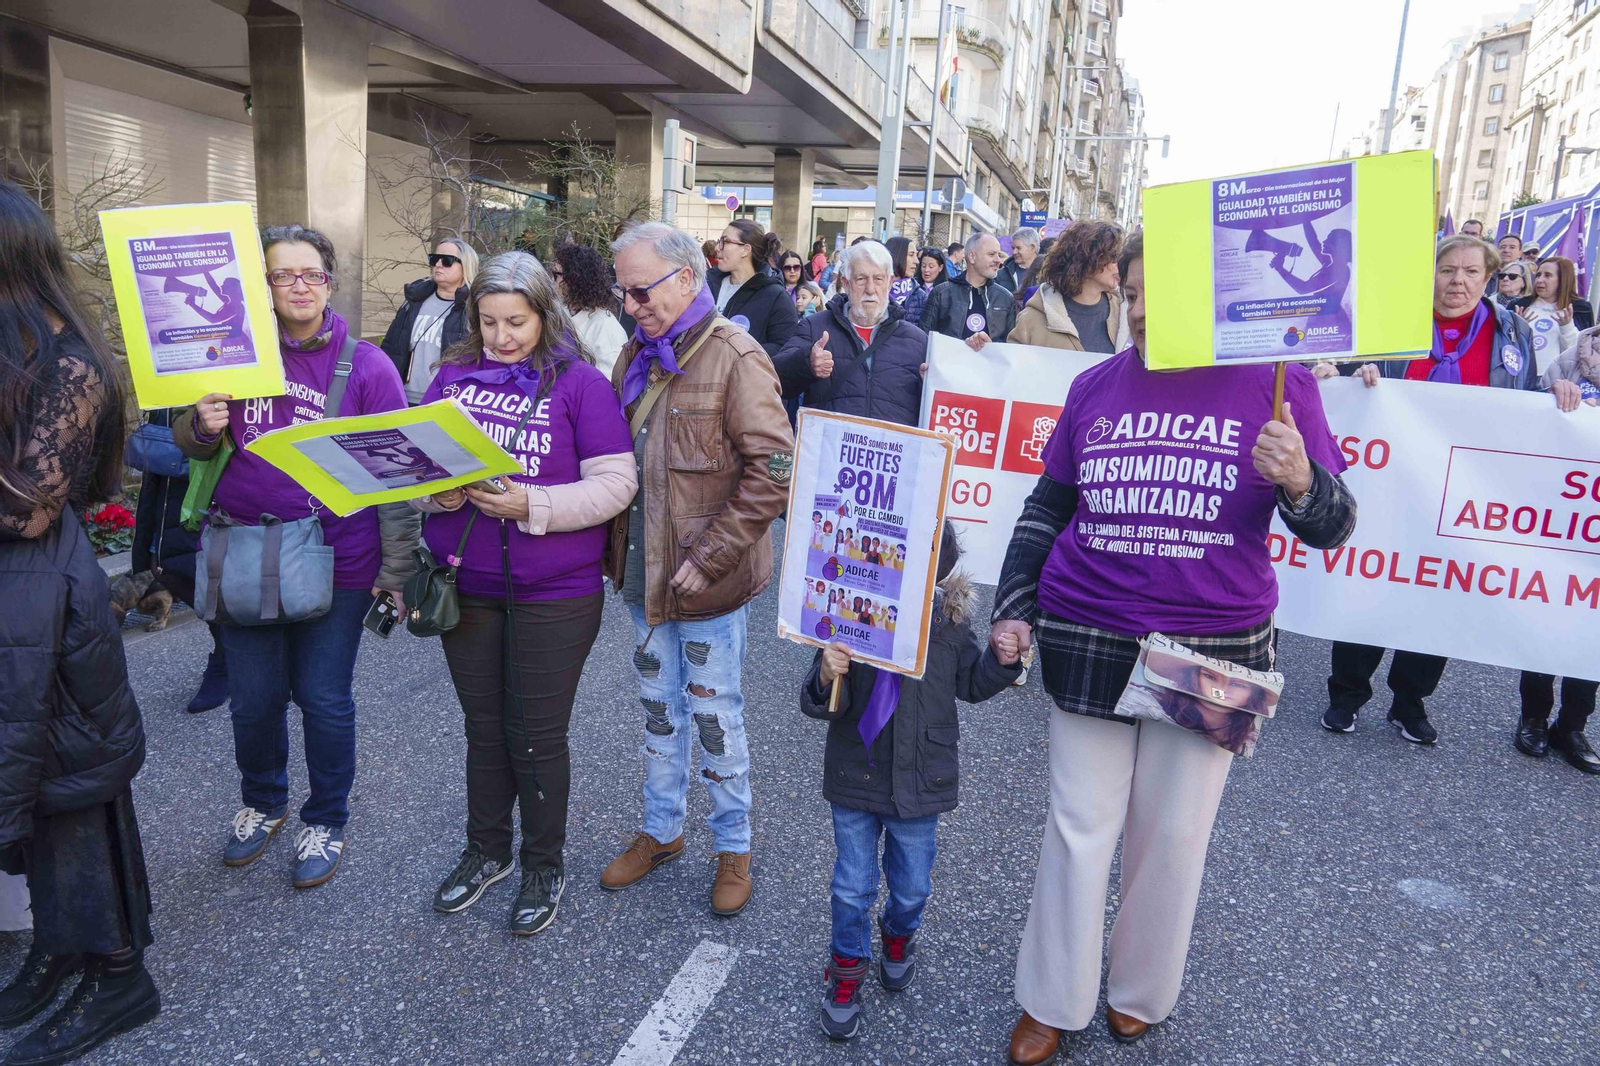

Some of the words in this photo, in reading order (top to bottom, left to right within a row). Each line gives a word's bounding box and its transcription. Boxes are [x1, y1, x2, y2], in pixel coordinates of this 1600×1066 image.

[1219, 198, 1265, 212] IGUALDAD
[1267, 191, 1310, 205] TAMBIÉN
[1313, 190, 1326, 199] EN
[1329, 188, 1341, 197] LA
[1219, 207, 1268, 222] ECONOMÍA
[1270, 207, 1276, 216] Y
[1279, 206, 1289, 215] EL
[1292, 199, 1341, 213] CONSUMO
[136, 253, 172, 263] IGUALDAD
[173, 250, 205, 259] TAMBIÉN
[138, 260, 177, 271] ECONOMÍA
[193, 256, 229, 266] CONSUMO
[892, 279, 913, 294] SOE
[1241, 310, 1272, 318] también
[1296, 306, 1321, 316] género
[1245, 301, 1275, 310] inflación
[1290, 297, 1326, 306] economía
[1306, 326, 1339, 336] ADICAE
[222, 345, 245, 353] ADICAE
[244, 398, 273, 424] 8M
[459, 384, 552, 419] ADICAE
[294, 405, 324, 420] CRÍTICAS
[482, 408, 518, 422] RESPONSABLES
[1111, 411, 1243, 447] ADICAE
[842, 432, 868, 446] JUNTAS
[869, 439, 888, 450] SOMOS
[889, 441, 903, 453] MÁS
[1147, 440, 1195, 449] RESPONSABLES
[1201, 445, 1239, 456] SOLIDARIOS
[1333, 435, 1390, 470] SO
[840, 444, 901, 474] FUERTES
[1077, 455, 1238, 492] CONSUMIDORAS
[854, 470, 897, 512] 8M
[1082, 487, 1223, 522] ORGANIZADAS
[854, 506, 866, 517] POR
[868, 509, 877, 519] EL
[878, 511, 904, 526] CAMBIO
[1087, 523, 1095, 535] EL
[1121, 525, 1135, 538] DEL
[1136, 526, 1180, 541] SISTEMA
[1182, 529, 1234, 546] FINANCIERO
[1086, 536, 1092, 547] Y
[1092, 537, 1107, 550] DEL
[1107, 540, 1140, 555] MODELO
[1143, 543, 1156, 556] DE
[1158, 543, 1205, 560] CONSUMO
[845, 564, 879, 581] ADICAE
[1265, 533, 1307, 568] DE
[1321, 546, 1549, 603] VIOLENCIA
[838, 624, 871, 641] ADICAE
